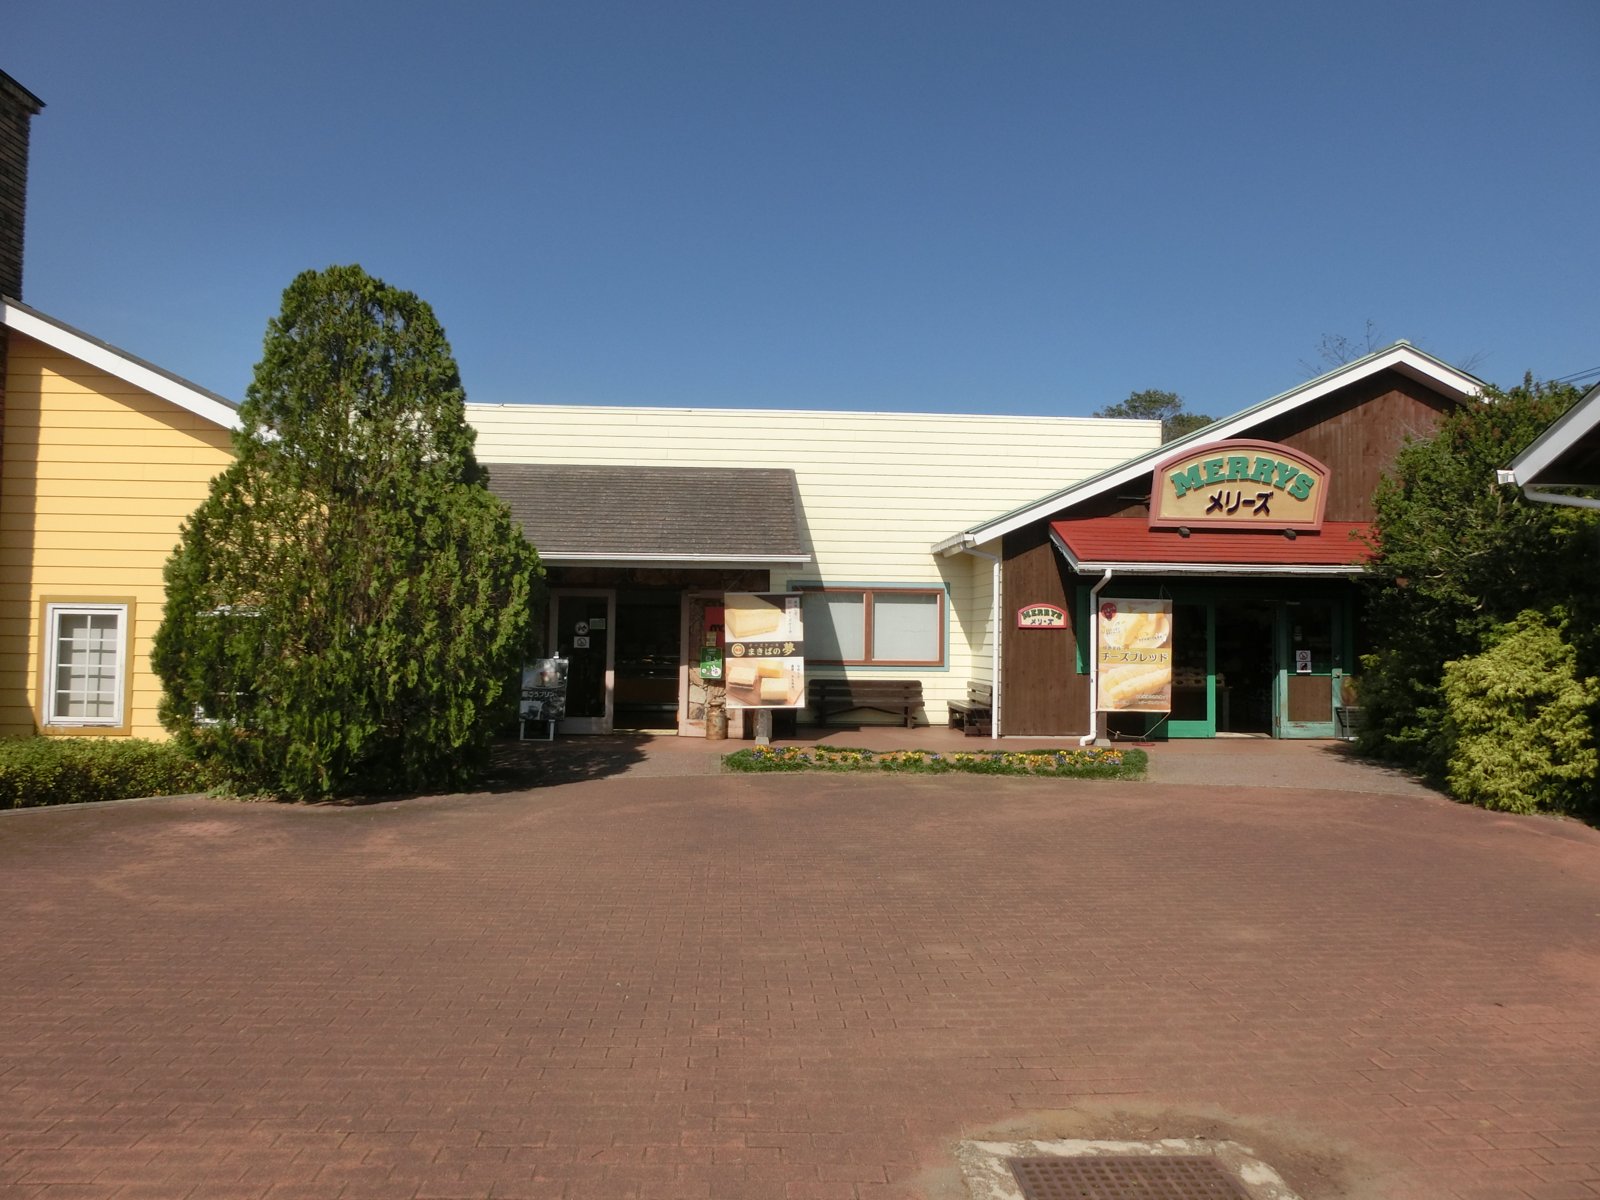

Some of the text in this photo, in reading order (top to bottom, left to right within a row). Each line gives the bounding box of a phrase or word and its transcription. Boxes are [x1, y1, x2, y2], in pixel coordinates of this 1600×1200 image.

[1170, 456, 1315, 501] MERRYS
[1206, 490, 1274, 516] メリーズ
[1022, 608, 1063, 620] MERRYS
[748, 641, 795, 656] まきばの夢
[1100, 651, 1169, 663] チーズブレッド
